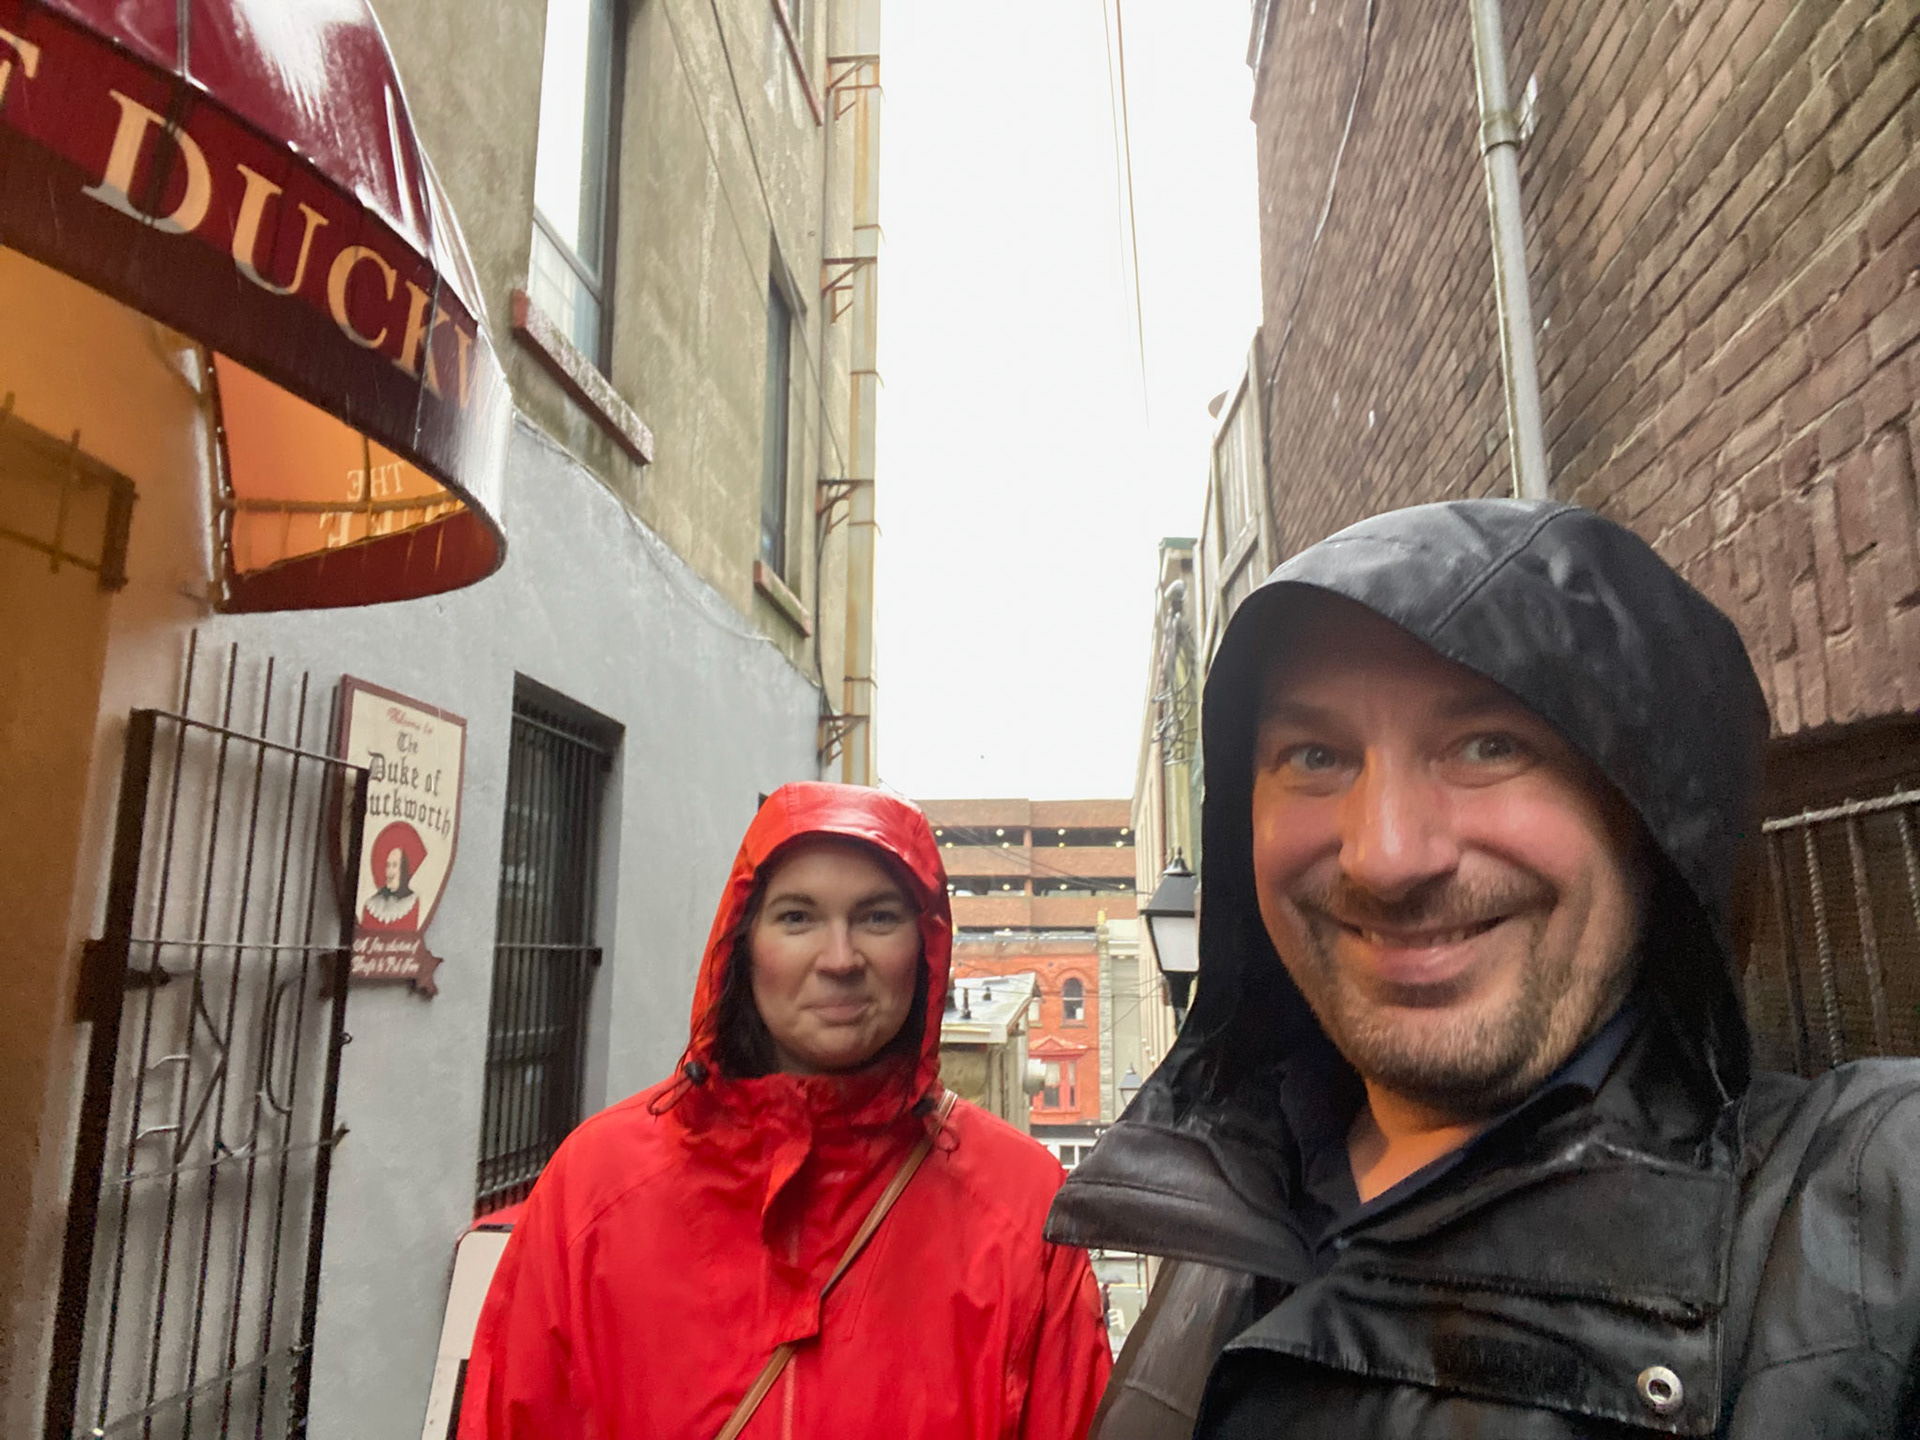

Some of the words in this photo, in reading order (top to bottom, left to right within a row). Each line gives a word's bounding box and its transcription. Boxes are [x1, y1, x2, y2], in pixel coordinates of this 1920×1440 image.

[397, 730, 419, 754] The
[368, 750, 420, 790] Duke
[424, 769, 442, 797] of
[366, 785, 451, 840] uckworth
